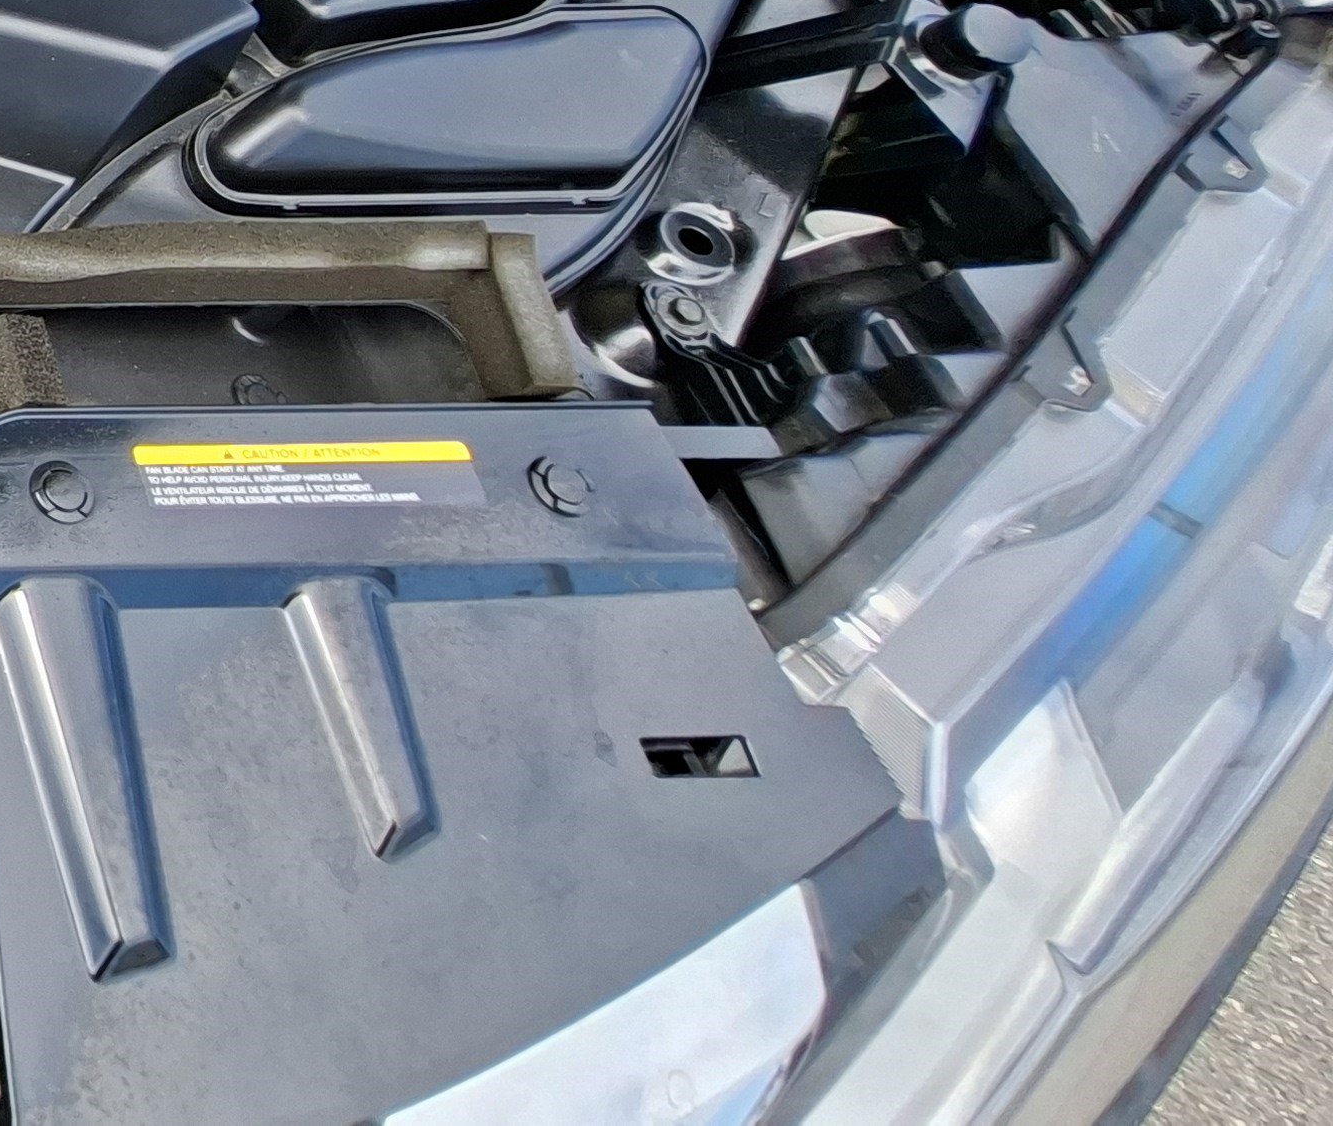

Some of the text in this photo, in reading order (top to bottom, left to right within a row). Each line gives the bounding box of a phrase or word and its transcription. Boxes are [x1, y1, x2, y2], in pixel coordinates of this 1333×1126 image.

[241, 448, 299, 460] CAUTION
[313, 447, 382, 459] ATTENTION
[145, 466, 162, 474] FAN
[163, 466, 190, 474] BLADE
[190, 465, 209, 474] CAN
[209, 465, 234, 474] START
[236, 465, 245, 473] AT
[247, 465, 263, 473] ANY
[148, 476, 160, 484] TO
[161, 475, 182, 484] HELP
[183, 475, 209, 483] AVOID
[209, 475, 253, 483] PERSONAL
[303, 473, 332, 482] HANDS
[151, 486, 162, 495] LE
[163, 486, 216, 495] VENTILATEUR
[216, 486, 247, 494] RISQUE
[248, 485, 259, 494] DE
[313, 484, 335, 493] TOUT
[154, 496, 179, 505] POUR
[179, 494, 208, 505] ÉVITER
[208, 495, 235, 505] TOUTE
[281, 494, 294, 504] NE
[293, 494, 311, 503] PAS
[324, 493, 376, 503] APPROCHER
[376, 493, 392, 502] LES
